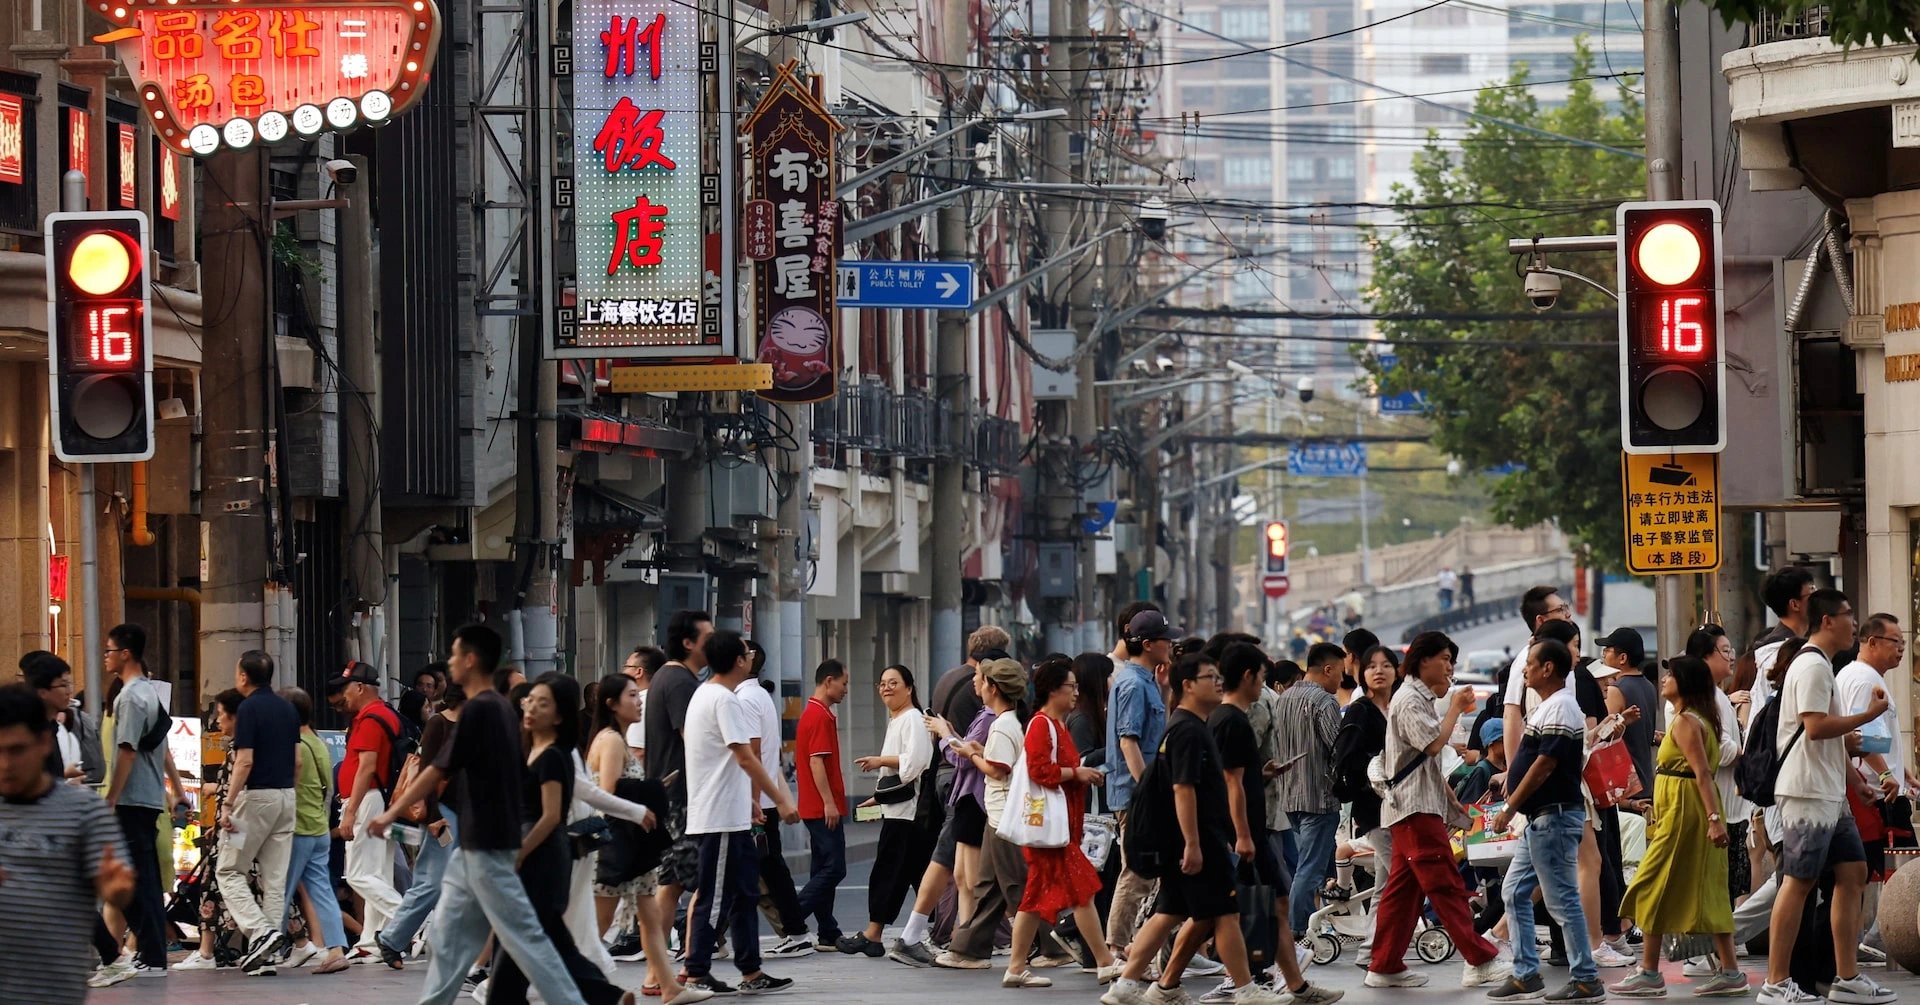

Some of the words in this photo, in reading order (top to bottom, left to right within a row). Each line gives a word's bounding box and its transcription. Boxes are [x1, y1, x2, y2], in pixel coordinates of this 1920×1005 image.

[92, 10, 320, 60] 一品名仕
[175, 73, 267, 110] 汤包
[194, 94, 387, 148] 上海特色汤包
[593, 13, 676, 276] 州饭店
[754, 204, 766, 256] 日本料理
[769, 148, 816, 300] 有喜屋
[810, 200, 839, 274] 深夜食堂
[870, 280, 895, 288] PUBLIC
[89, 308, 132, 362] 16
[579, 299, 698, 325] 上海餐饮名店
[1661, 298, 1703, 352] 16
[1630, 490, 1714, 508] 停车行为违法
[1639, 509, 1709, 526] 请立即驶离
[1632, 529, 1714, 547] 电子警察监管
